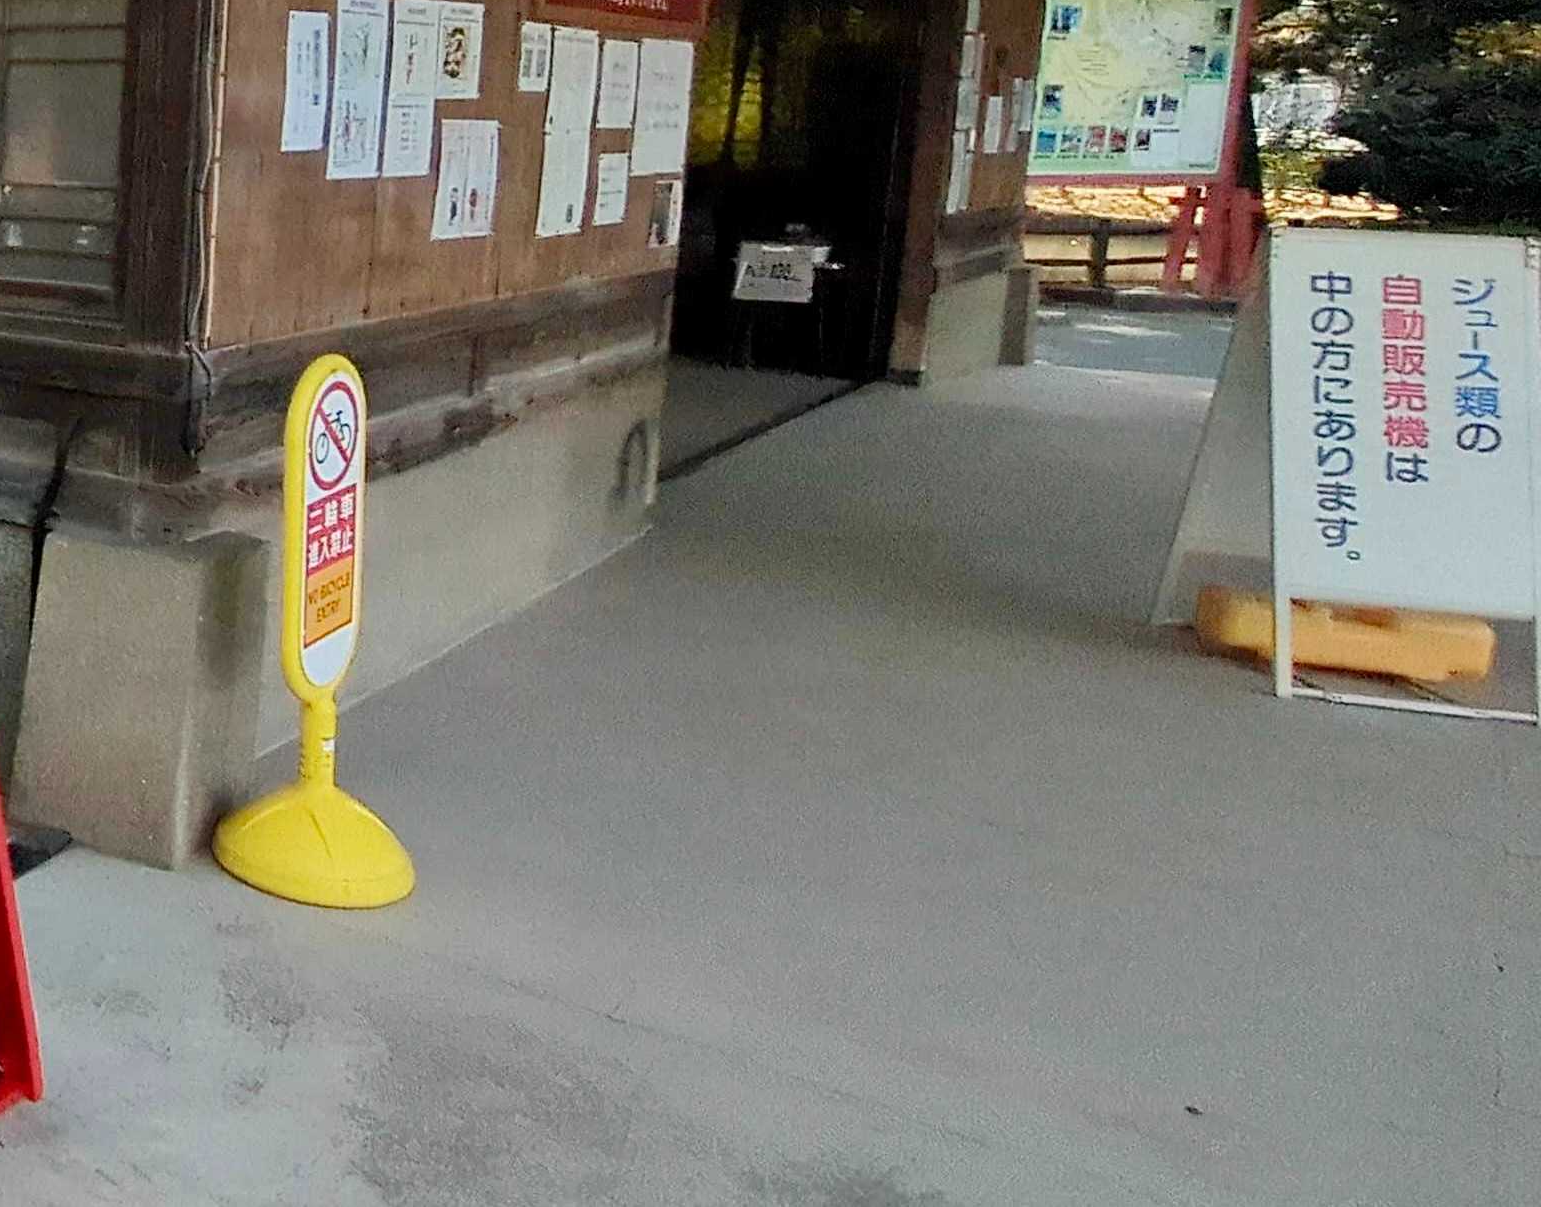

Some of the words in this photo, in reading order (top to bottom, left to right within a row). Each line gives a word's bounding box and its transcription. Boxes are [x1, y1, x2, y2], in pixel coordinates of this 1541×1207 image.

[1310, 270, 1361, 562] 中の方にあります。
[1381, 274, 1430, 484] 自動販売機は
[1451, 277, 1503, 454] ジュース類の
[307, 525, 353, 569] 進入禁止
[308, 492, 354, 535] 二輪車
